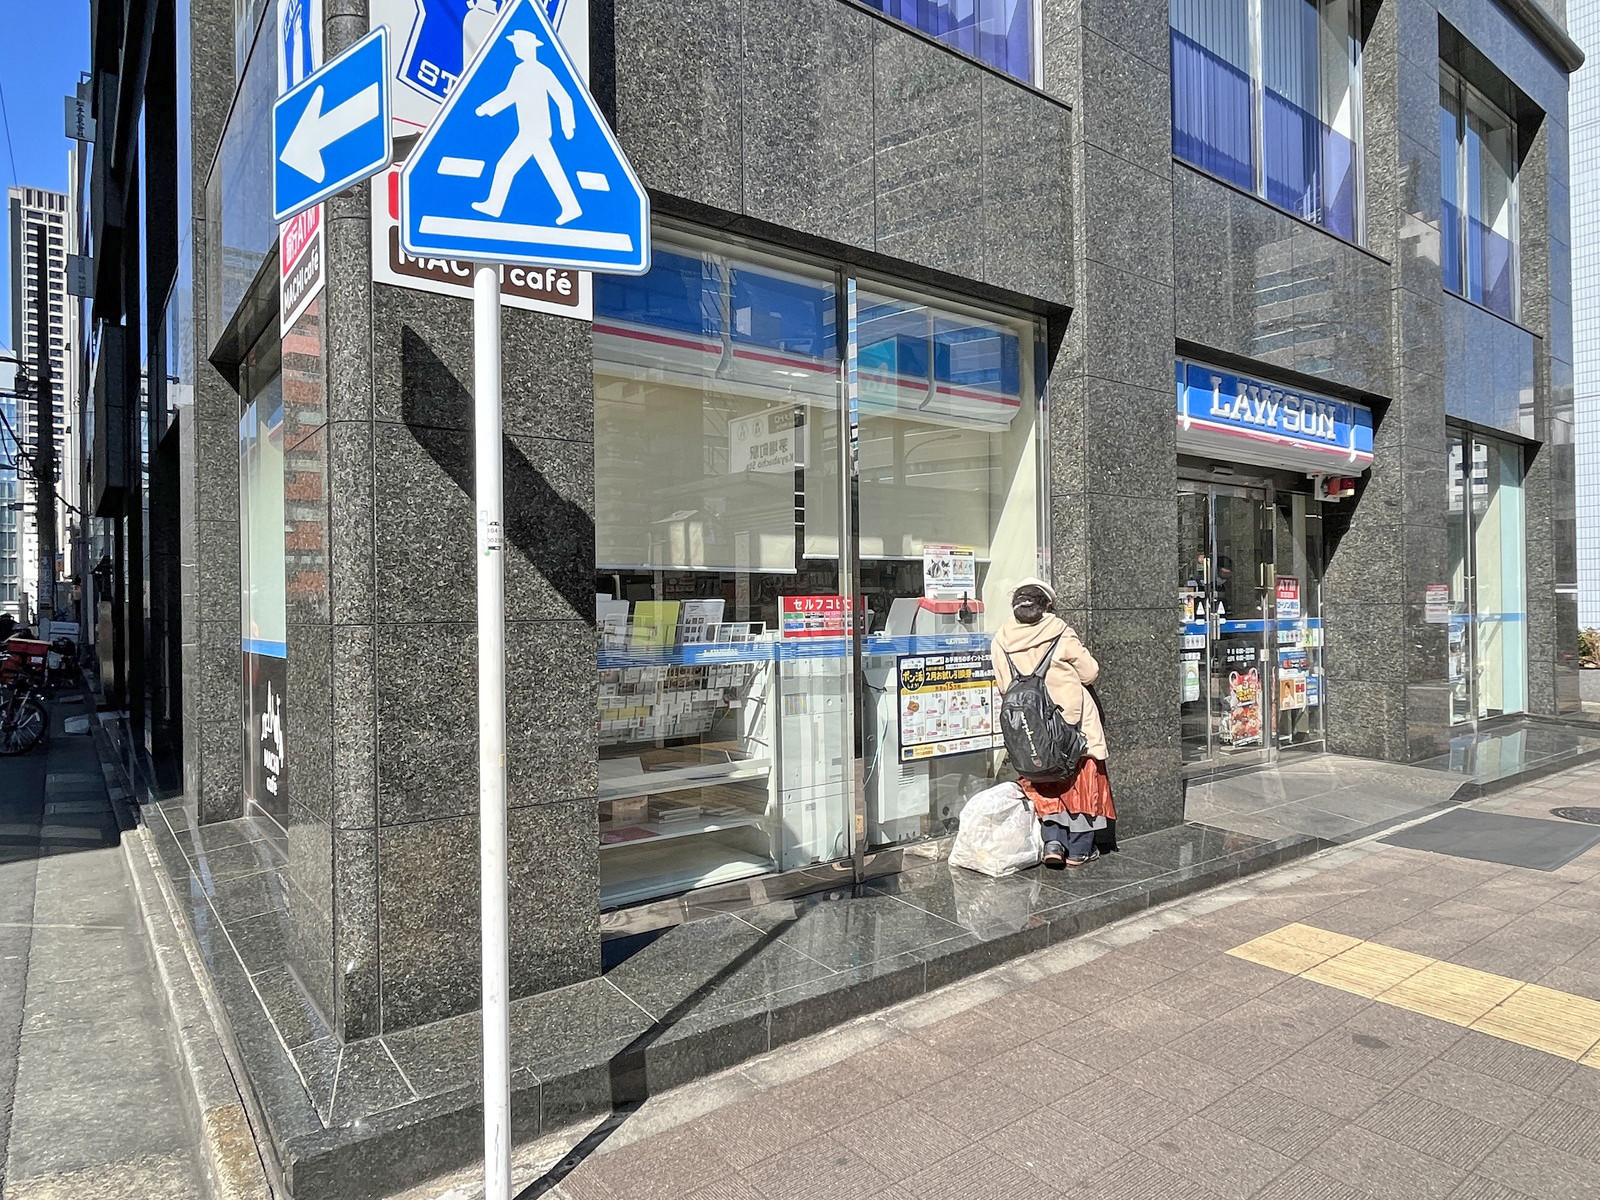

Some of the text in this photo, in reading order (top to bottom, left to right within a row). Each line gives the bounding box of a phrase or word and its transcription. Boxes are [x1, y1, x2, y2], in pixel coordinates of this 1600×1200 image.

[284, 245, 319, 314] MACHI café
[398, 247, 572, 296] MACI café
[1209, 375, 1337, 441] LAWSON
[1278, 580, 1297, 591] ATM
